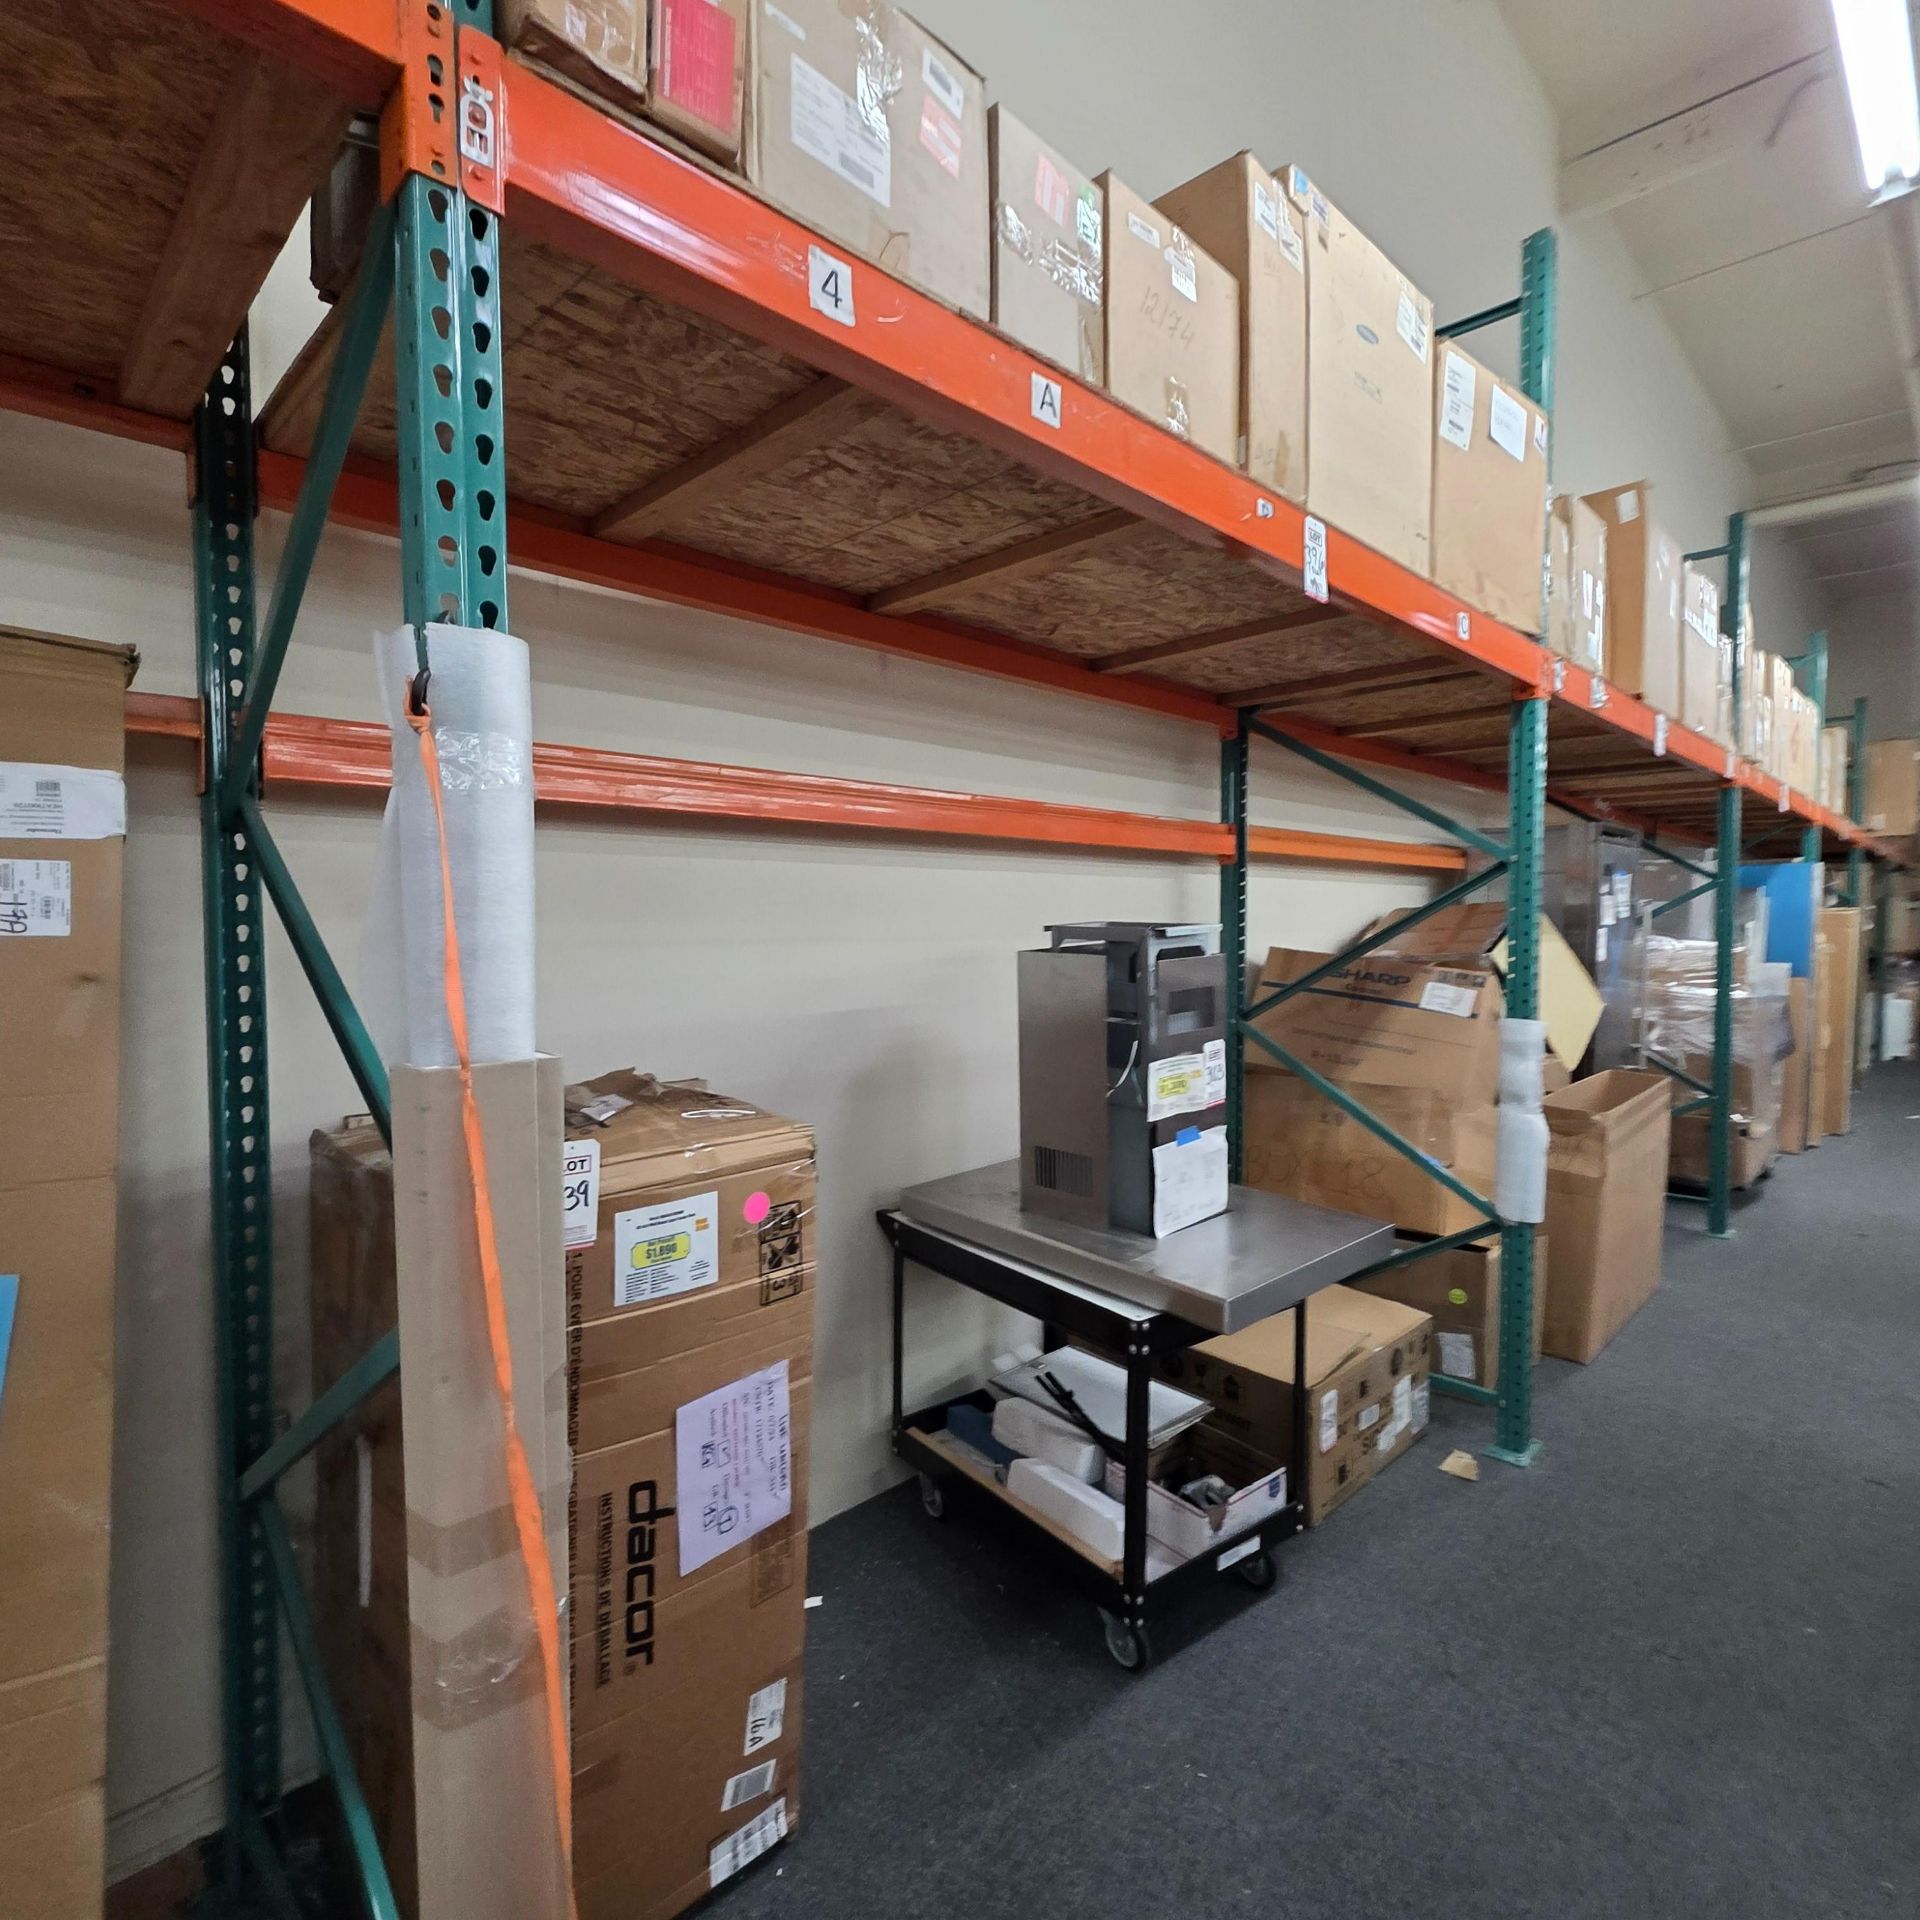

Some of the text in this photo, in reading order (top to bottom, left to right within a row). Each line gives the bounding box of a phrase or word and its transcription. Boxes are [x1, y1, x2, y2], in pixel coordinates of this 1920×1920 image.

[820, 270, 842, 308] 4
[1038, 383, 1059, 417] A
[563, 1158, 588, 1173] OT
[571, 1265, 583, 1301] POUR
[597, 1491, 614, 1587] INSTRUCTIONS
[626, 1479, 677, 1666] dacor
[598, 1590, 613, 1608] DE
